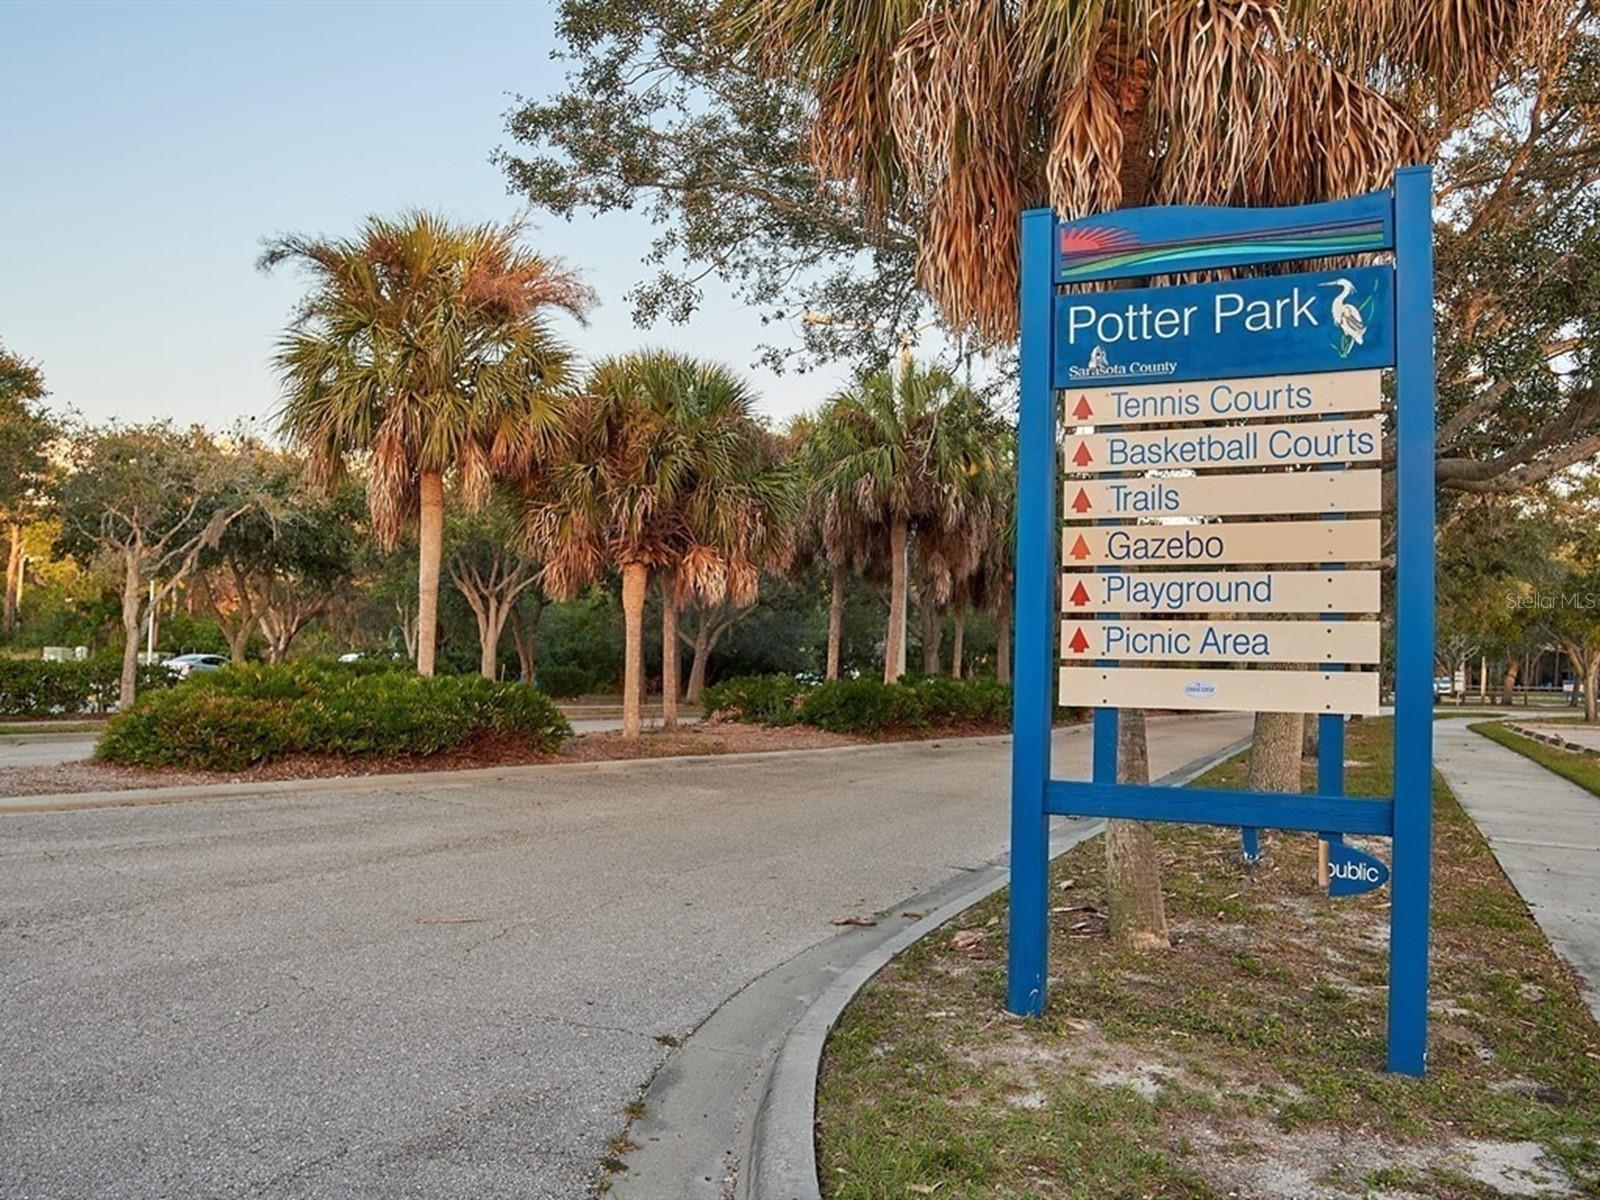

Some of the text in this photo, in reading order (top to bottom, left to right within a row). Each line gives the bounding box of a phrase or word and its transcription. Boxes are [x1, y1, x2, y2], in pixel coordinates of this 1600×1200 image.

[1068, 287, 1319, 345] Potter Park
[1129, 361, 1178, 376] County
[1111, 383, 1313, 418] Tennis Courts
[1109, 427, 1374, 465] Basketball Courts
[1110, 484, 1180, 511] Trails
[1107, 531, 1224, 560] Gazebo
[1105, 575, 1272, 609] Playground
[1105, 626, 1270, 655] Picnic Area
